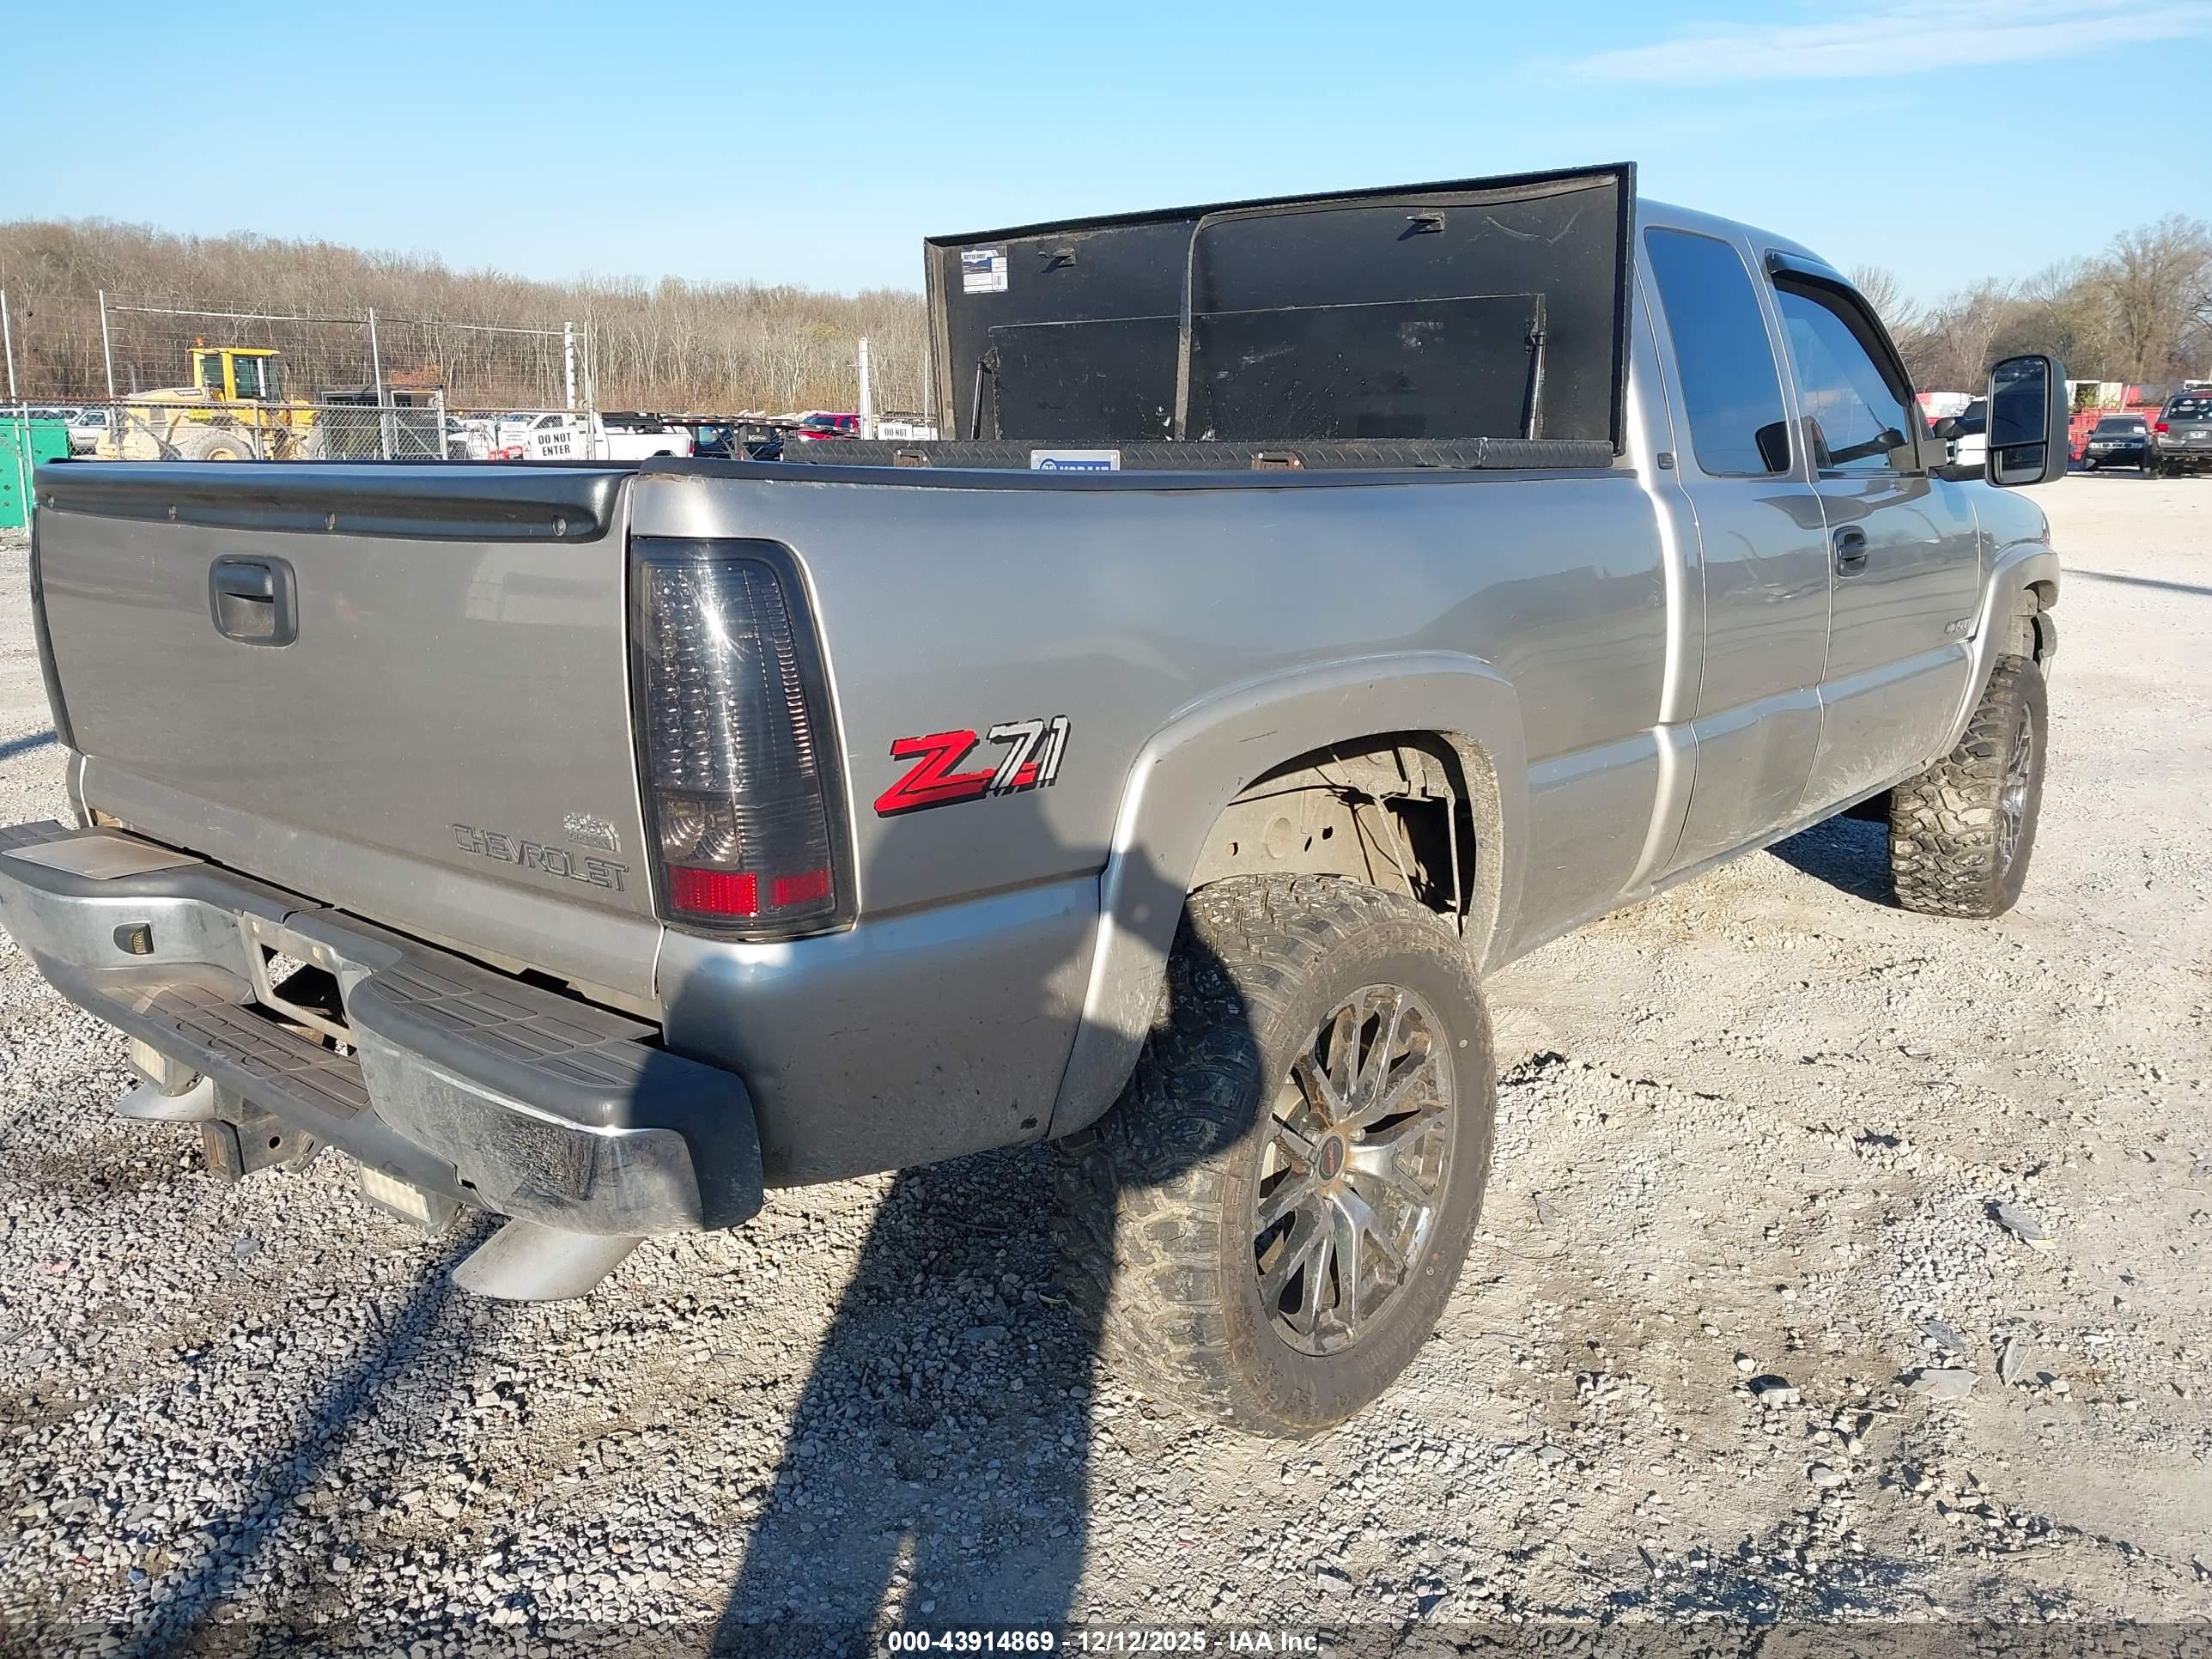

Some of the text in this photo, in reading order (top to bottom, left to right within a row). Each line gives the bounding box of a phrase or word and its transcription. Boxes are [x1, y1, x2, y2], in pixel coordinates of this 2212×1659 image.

[538, 432, 571, 445] DO NOT
[884, 428, 894, 437] DO
[896, 428, 908, 437] NOT
[542, 444, 570, 456] ENTER
[873, 714, 1072, 818] Z71
[453, 823, 629, 891] CHEVROLET
